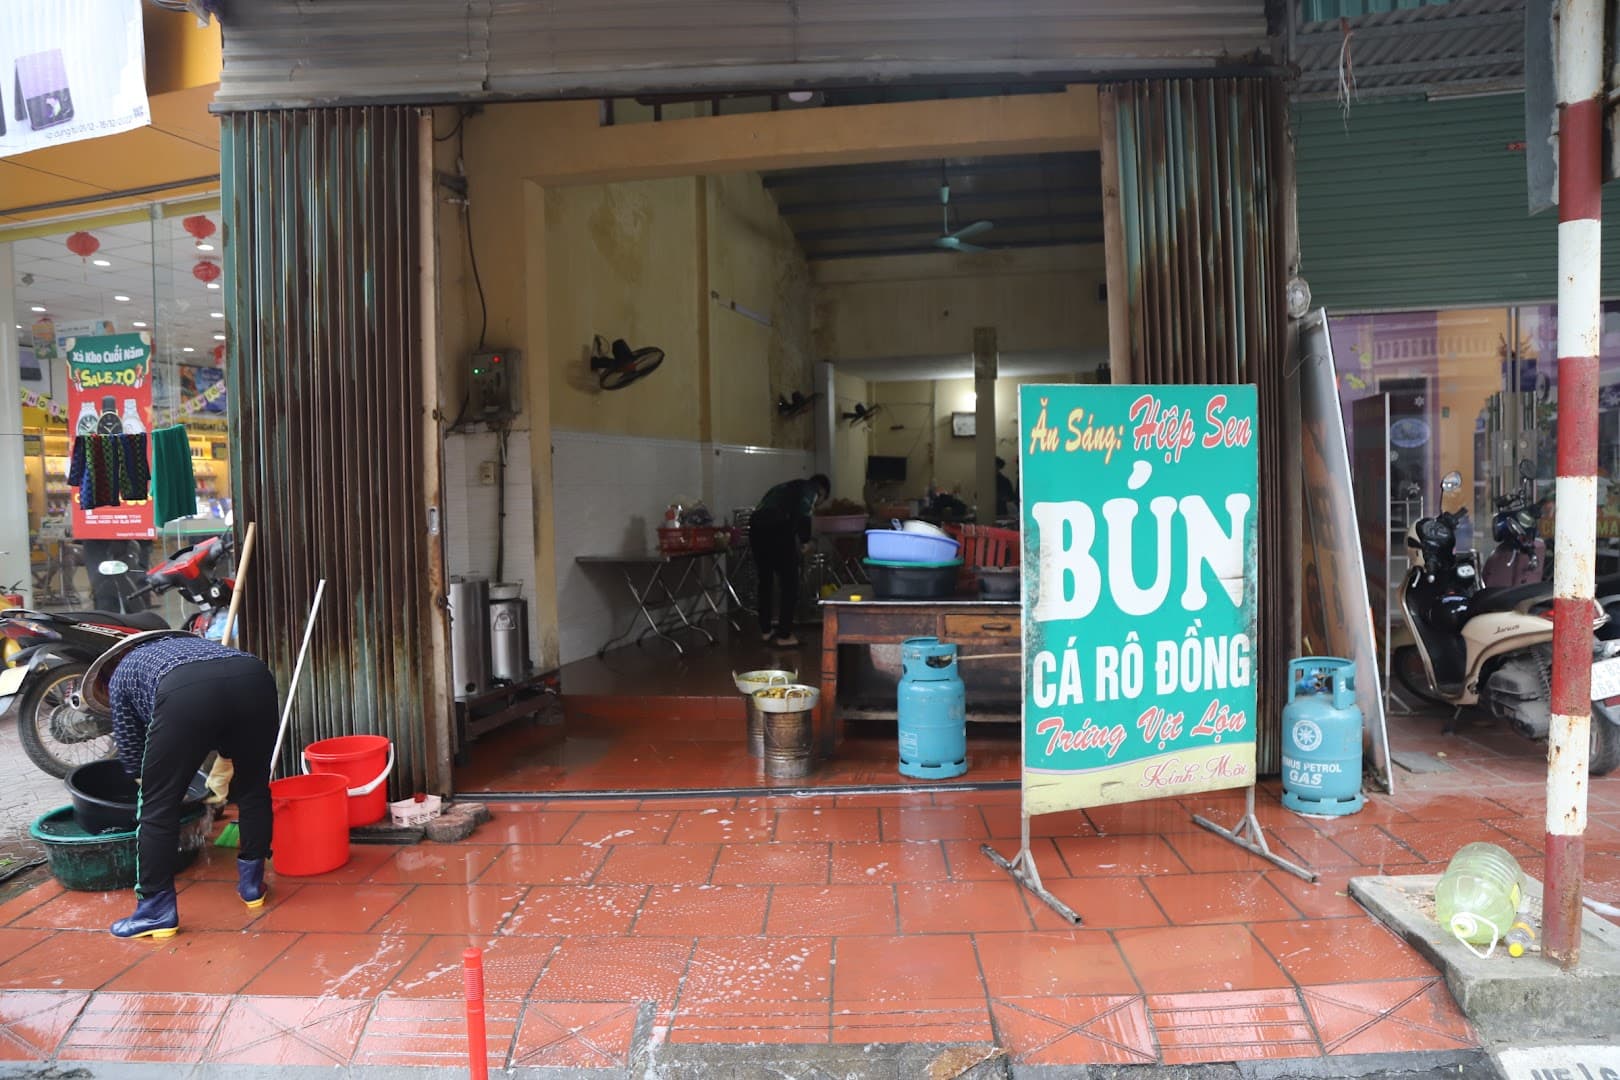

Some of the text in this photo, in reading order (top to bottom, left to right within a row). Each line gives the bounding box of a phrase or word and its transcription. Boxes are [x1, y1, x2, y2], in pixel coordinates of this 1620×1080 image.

[80, 369, 113, 388] SALE
[85, 351, 102, 363] Kho
[123, 346, 144, 361] Năm
[1029, 397, 1125, 464] Ăn Sáng:
[1129, 393, 1252, 464] Hiệp Sen
[1031, 460, 1251, 622] BÚN
[1032, 618, 1251, 709] CÁ RÔ ĐỒNG
[1036, 716, 1126, 758] Trứng
[1137, 705, 1184, 751] Vịt
[1191, 698, 1247, 744] Lộn
[1289, 769, 1323, 785] GAS
[1303, 762, 1342, 774] PETROL
